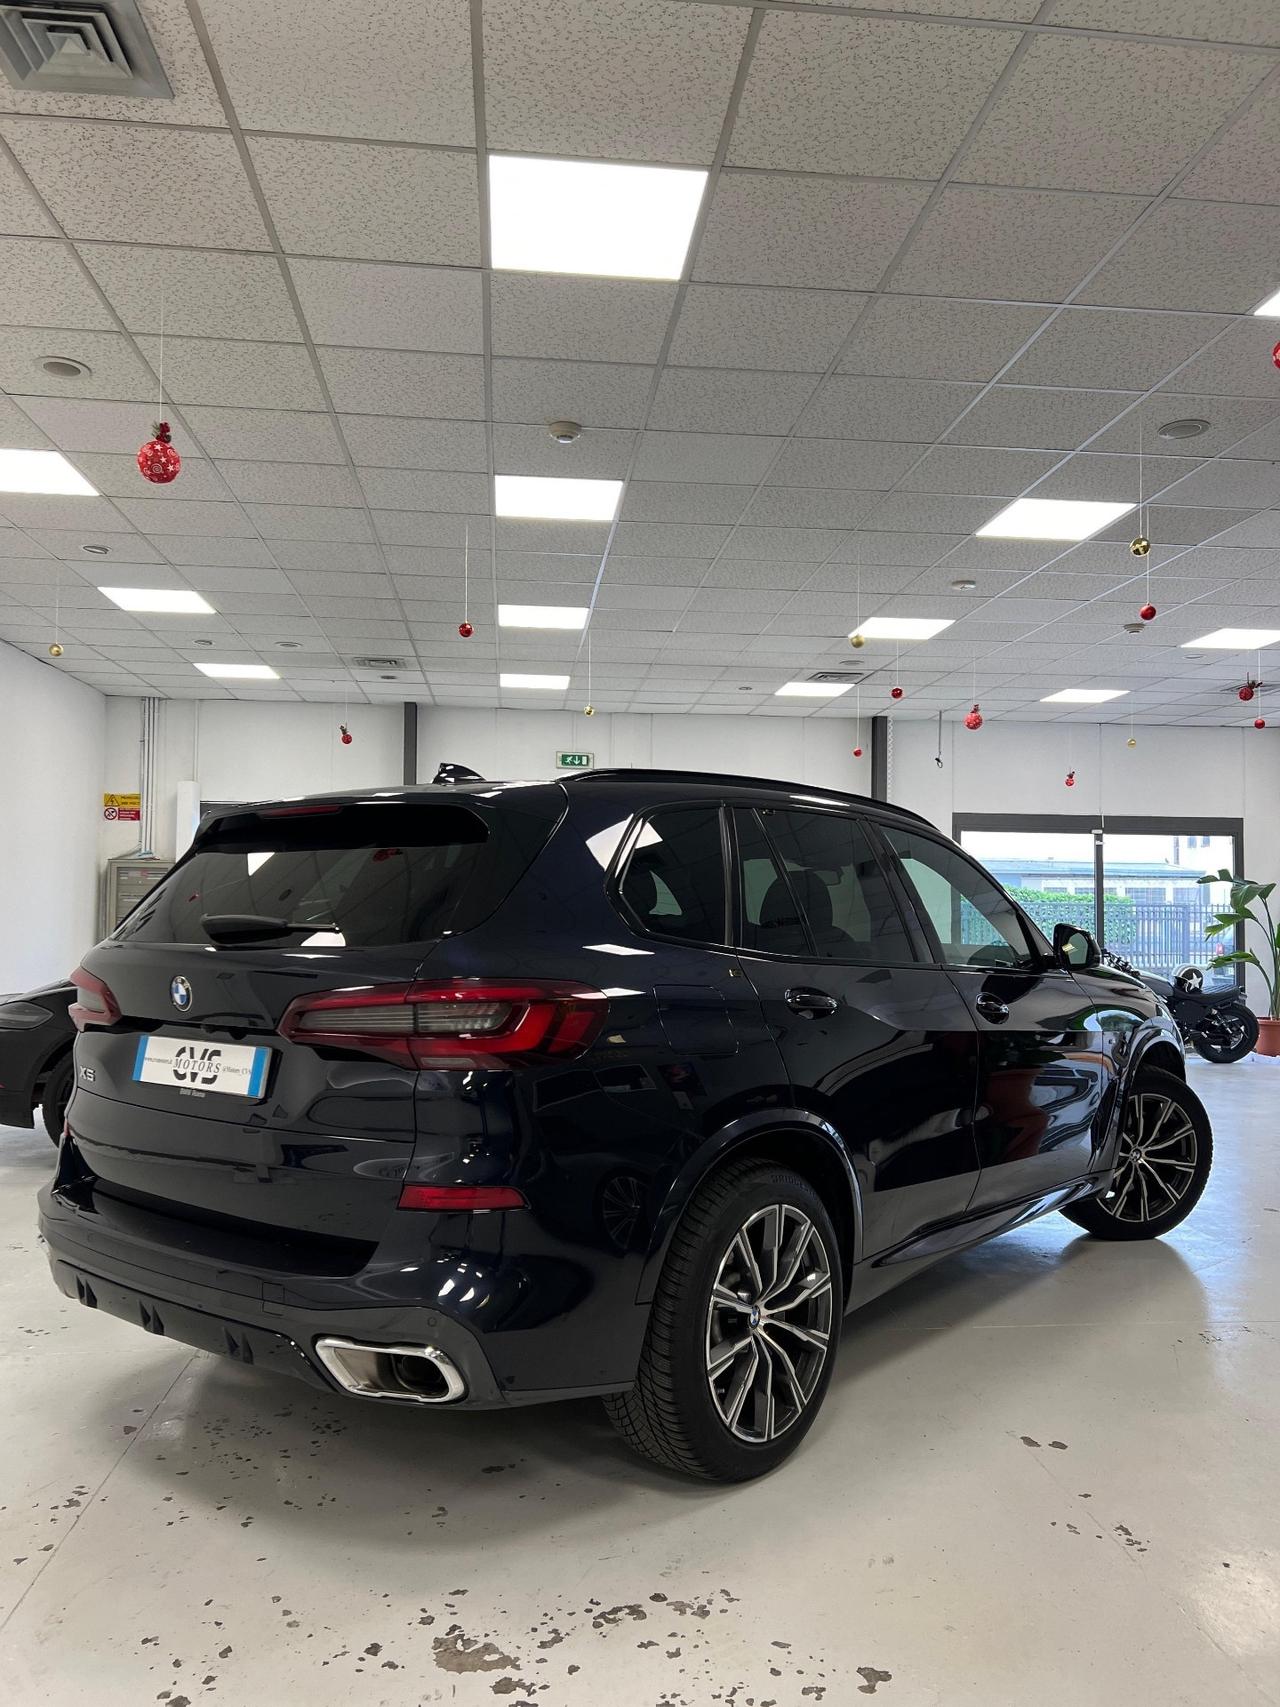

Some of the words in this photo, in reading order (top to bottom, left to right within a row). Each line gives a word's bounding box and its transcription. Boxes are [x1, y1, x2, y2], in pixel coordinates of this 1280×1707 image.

[79, 1065, 94, 1081] X5
[173, 1046, 221, 1084] CVS
[173, 1058, 221, 1074] MOTORS
